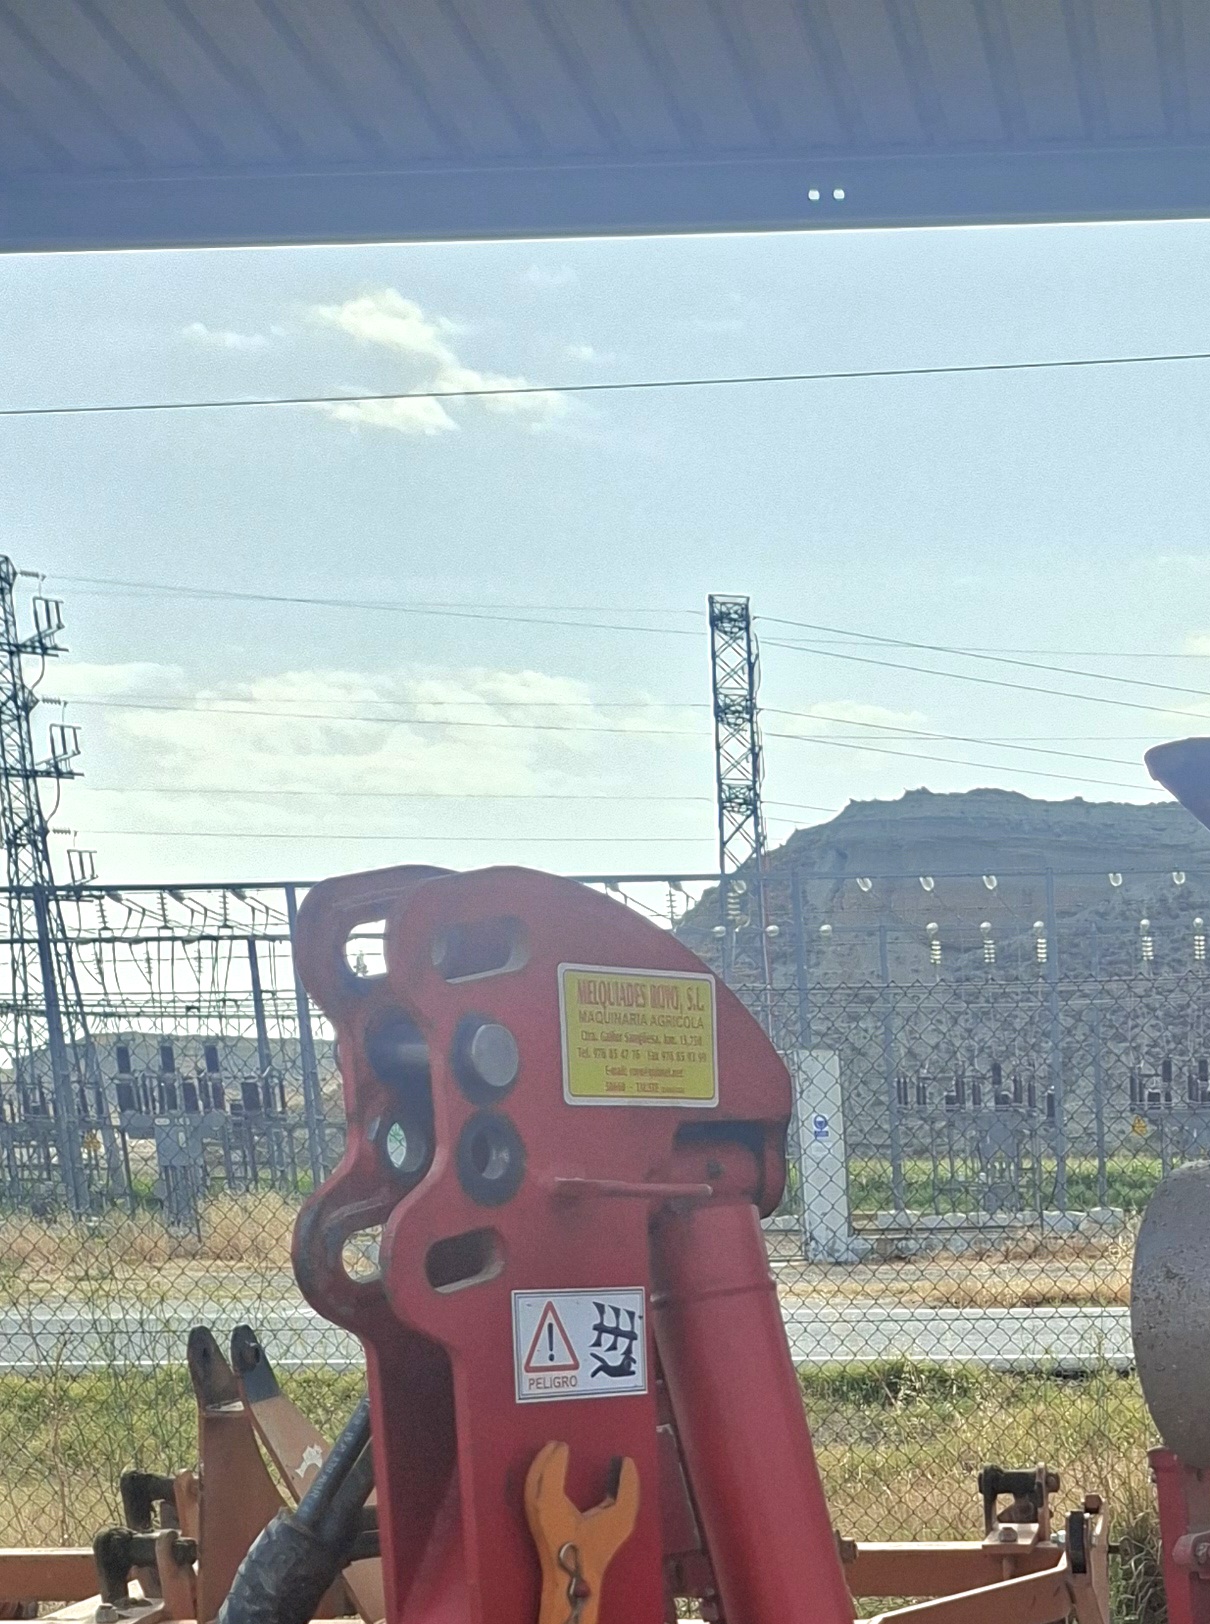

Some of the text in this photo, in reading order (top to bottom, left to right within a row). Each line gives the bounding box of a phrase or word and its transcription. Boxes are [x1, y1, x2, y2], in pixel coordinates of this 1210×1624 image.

[578, 979, 646, 1010] MELQUIADES
[578, 1010, 648, 1026] MAQUINARIA
[528, 1375, 578, 1390] PELIGRO
